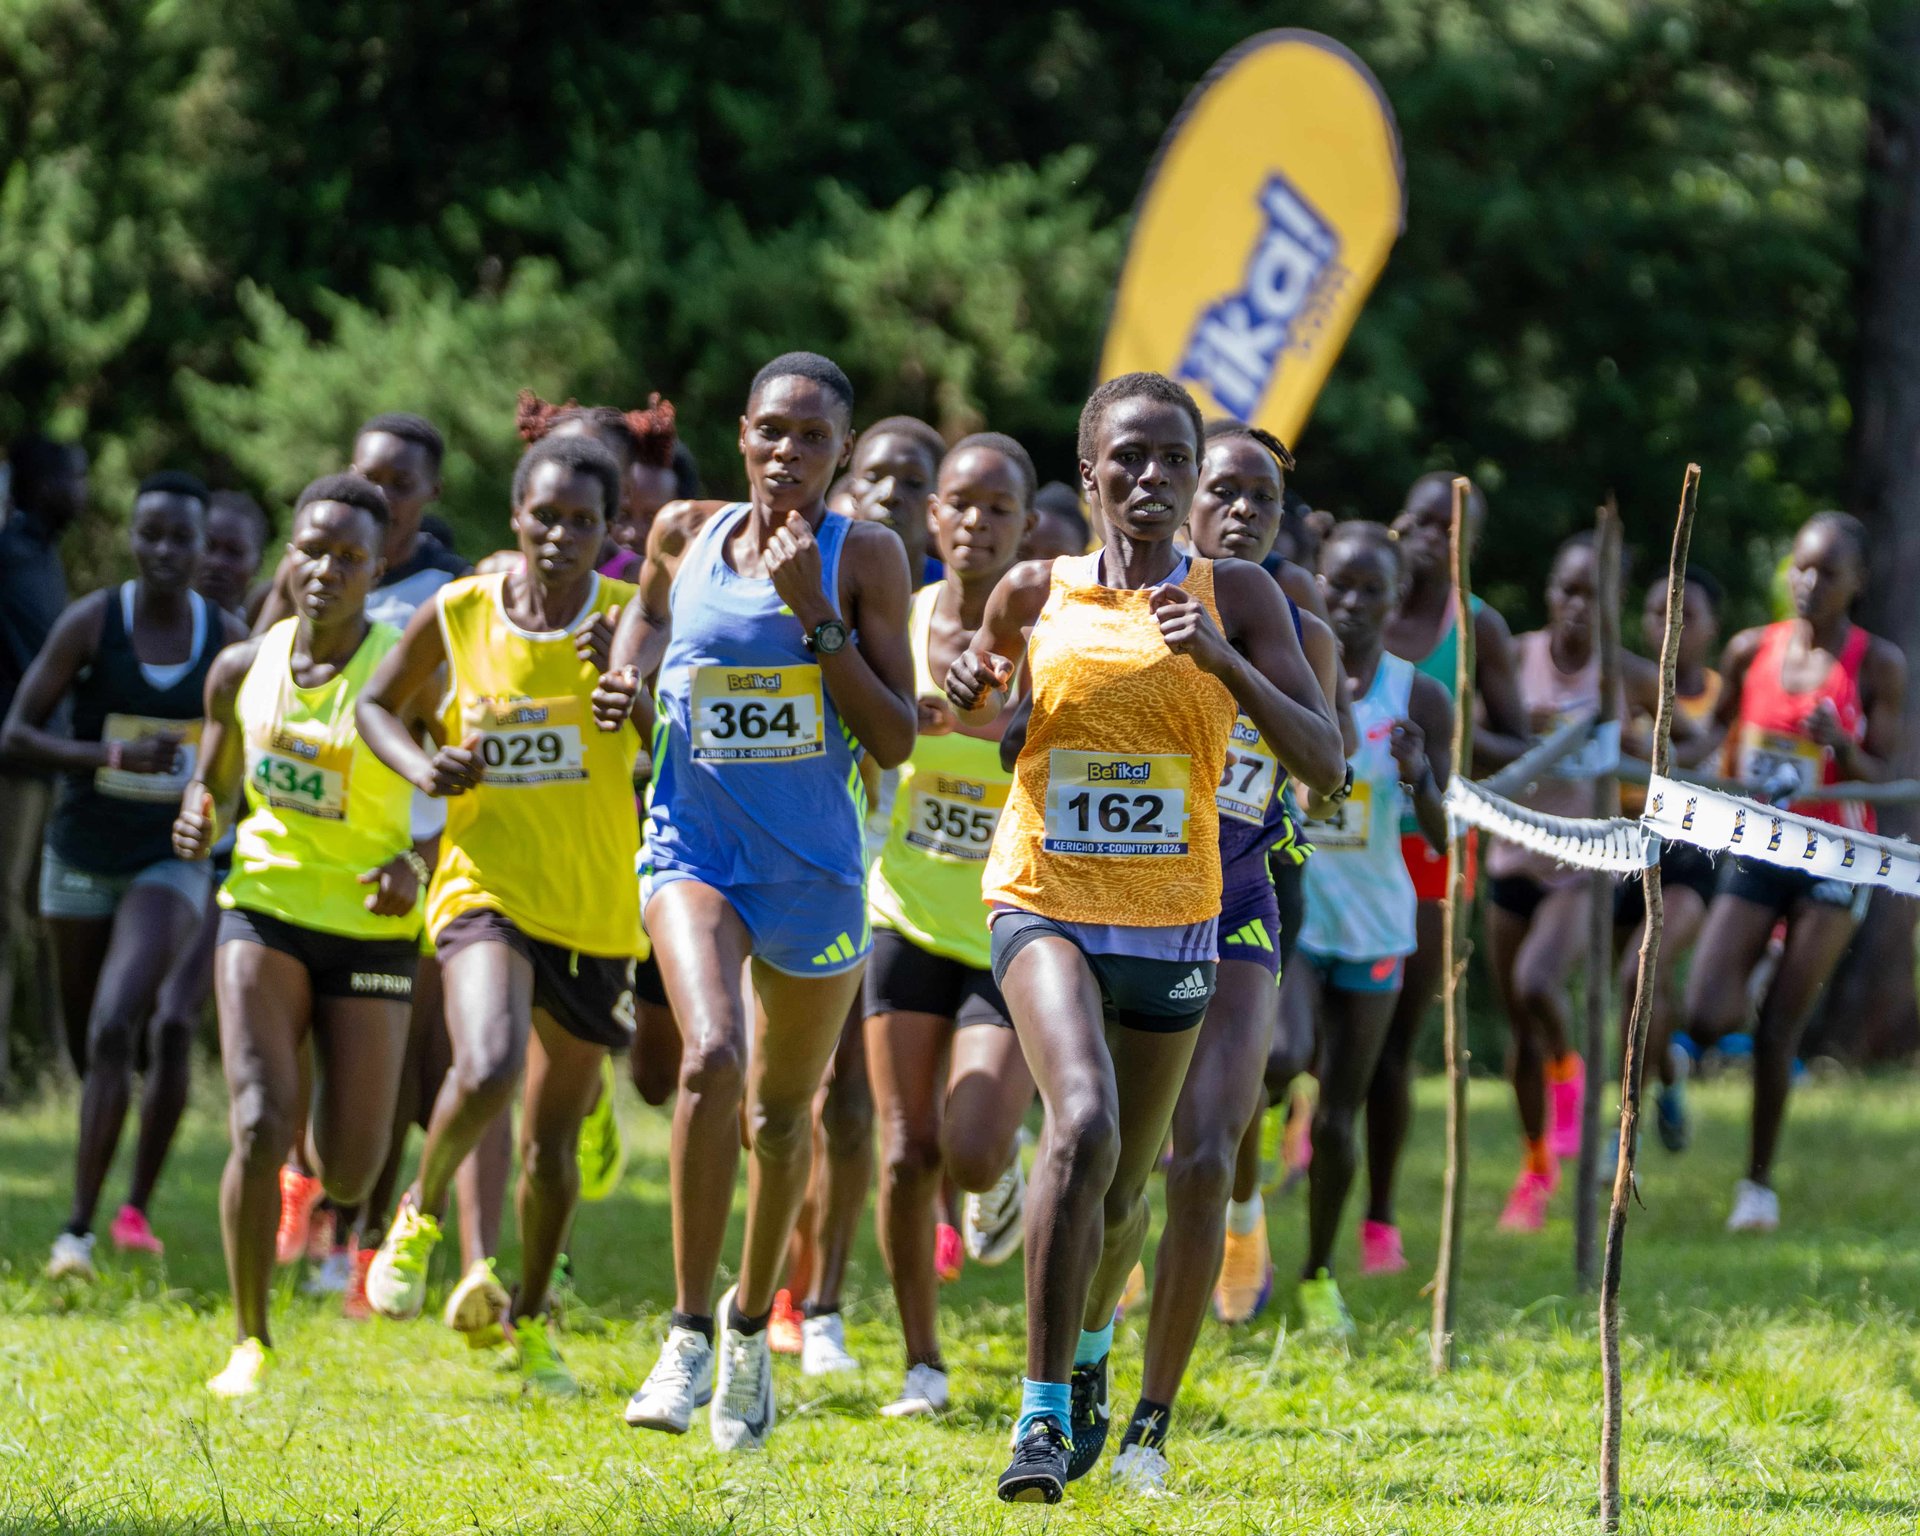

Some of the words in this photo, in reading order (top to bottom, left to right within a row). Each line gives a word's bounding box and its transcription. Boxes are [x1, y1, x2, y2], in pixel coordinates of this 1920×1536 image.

[1182, 174, 1340, 418] ika!
[727, 673, 782, 691] Betika!
[710, 702, 800, 739] 364
[1230, 721, 1260, 744] ika!
[482, 731, 565, 768] 029
[699, 748, 737, 758] KERICHO
[740, 747, 793, 758] X-COUNTRY
[795, 743, 817, 754] 2026
[256, 757, 326, 801] 434
[1088, 762, 1151, 781] Betika!
[924, 798, 995, 843] 355
[1068, 792, 1164, 834] 162
[1053, 840, 1095, 852] KERICHO
[1097, 842, 1154, 853] X-COUNTRY
[1155, 844, 1181, 854] 2026
[350, 972, 412, 993] KIPRUN
[1169, 986, 1208, 999] adidas
